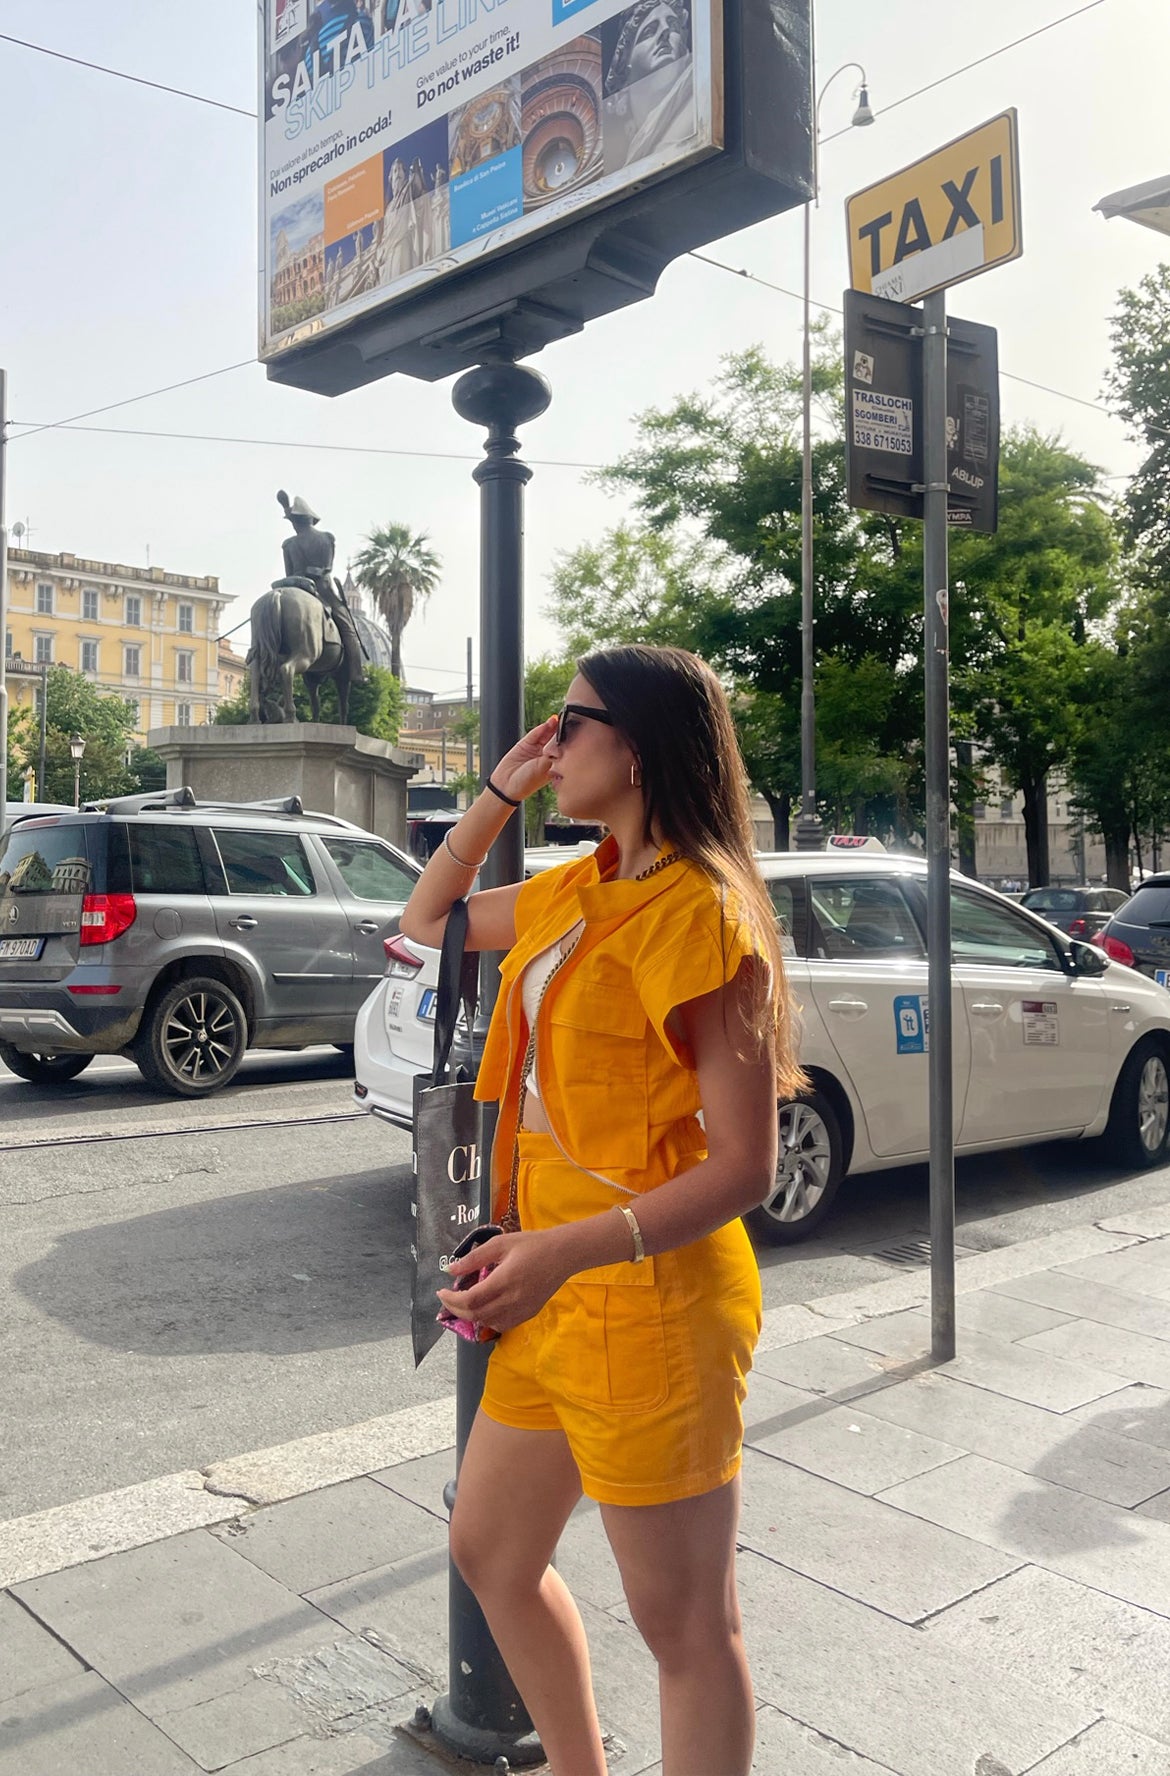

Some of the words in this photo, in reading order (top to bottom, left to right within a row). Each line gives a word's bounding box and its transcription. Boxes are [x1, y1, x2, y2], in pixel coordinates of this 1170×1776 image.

[271, 20, 368, 116] SALTA
[285, 61, 355, 140] SKIP
[360, 11, 430, 90] THE
[436, 0, 507, 45] LI
[416, 71, 435, 88] Give
[435, 57, 458, 77] value
[458, 52, 468, 63] to
[468, 38, 488, 59] your
[489, 25, 511, 44] time.
[417, 88, 436, 109] Do
[437, 70, 460, 97] not
[461, 48, 504, 81] waste
[506, 31, 520, 55] it!
[270, 177, 292, 198] Non
[292, 143, 345, 184] sprecarlo
[346, 136, 358, 151] in
[358, 110, 392, 143] coda!
[858, 154, 1003, 278] TAXI
[854, 391, 912, 411] TRASLOCHI
[855, 408, 898, 425] SGOMBERI
[855, 430, 871, 446] 338
[874, 434, 912, 453] 6715053
[952, 466, 984, 489] ABLUP
[833, 837, 867, 847] TAXI
[447, 1144, 481, 1184] Ch
